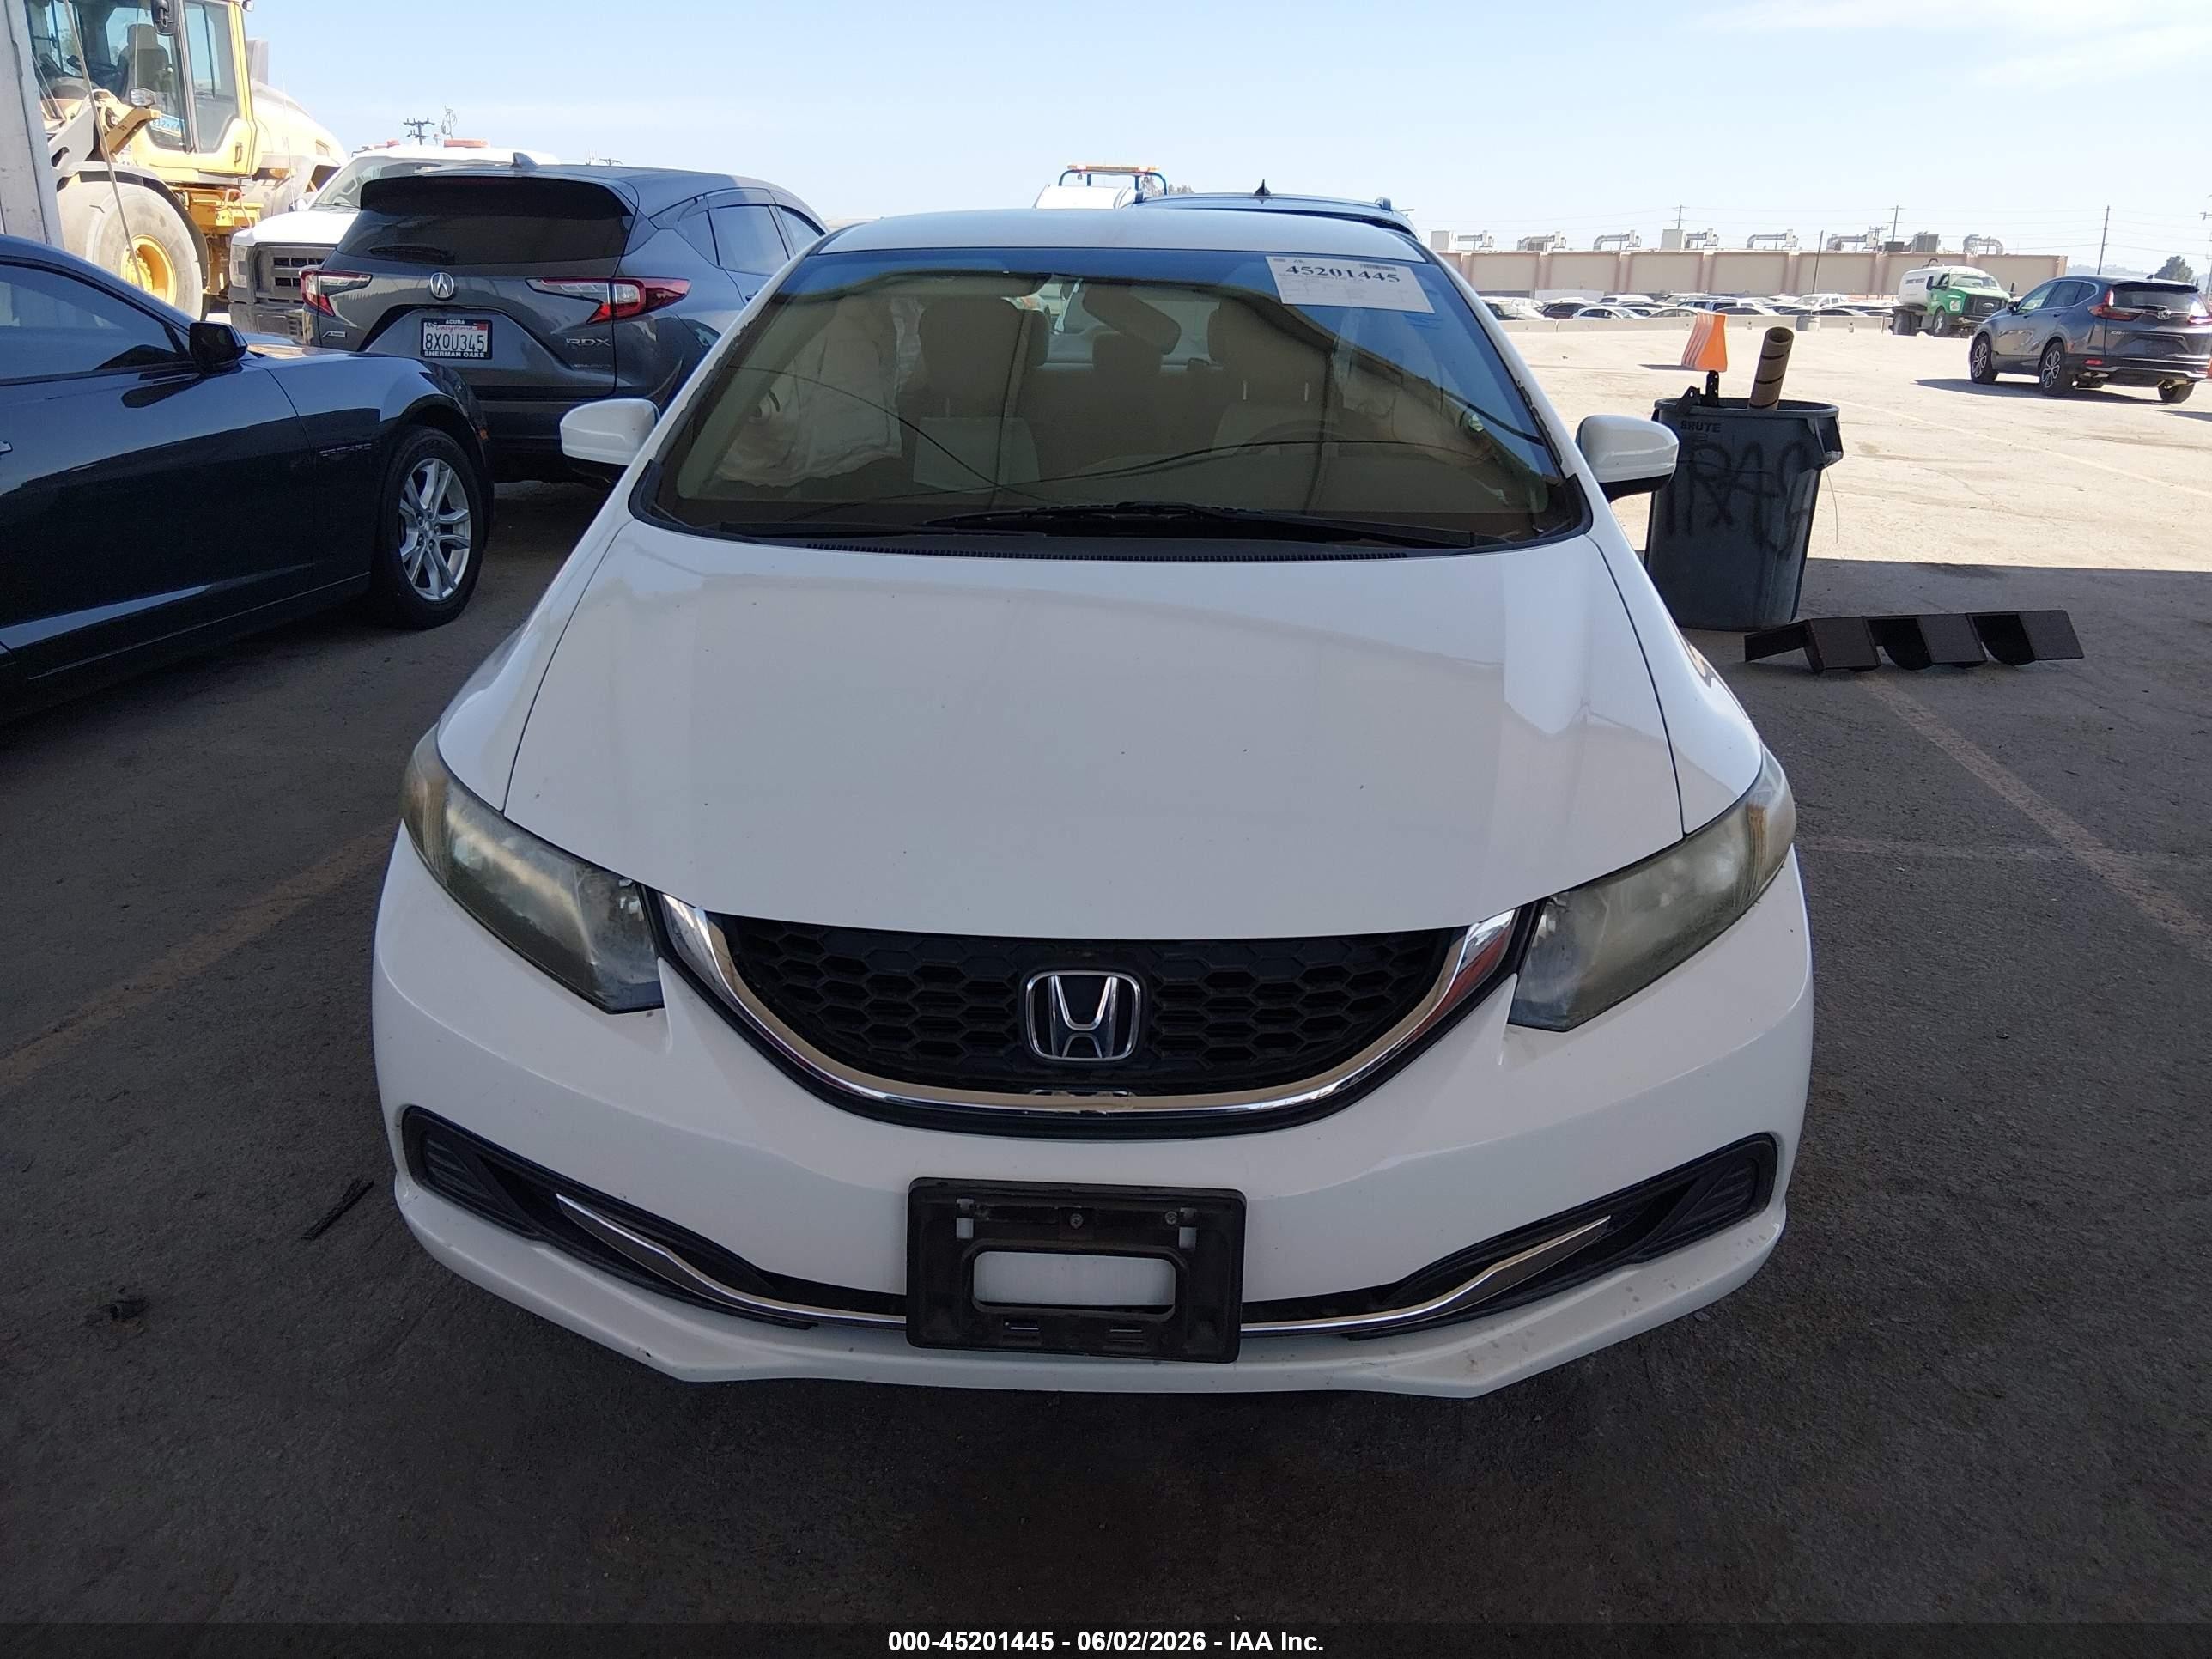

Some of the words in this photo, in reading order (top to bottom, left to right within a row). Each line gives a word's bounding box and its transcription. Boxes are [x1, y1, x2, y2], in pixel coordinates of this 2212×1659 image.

[1286, 265, 1401, 283] 45201445
[425, 333, 484, 351] 8XQU345
[566, 338, 611, 347] RDX
[1680, 420, 1722, 433] BRUTE
